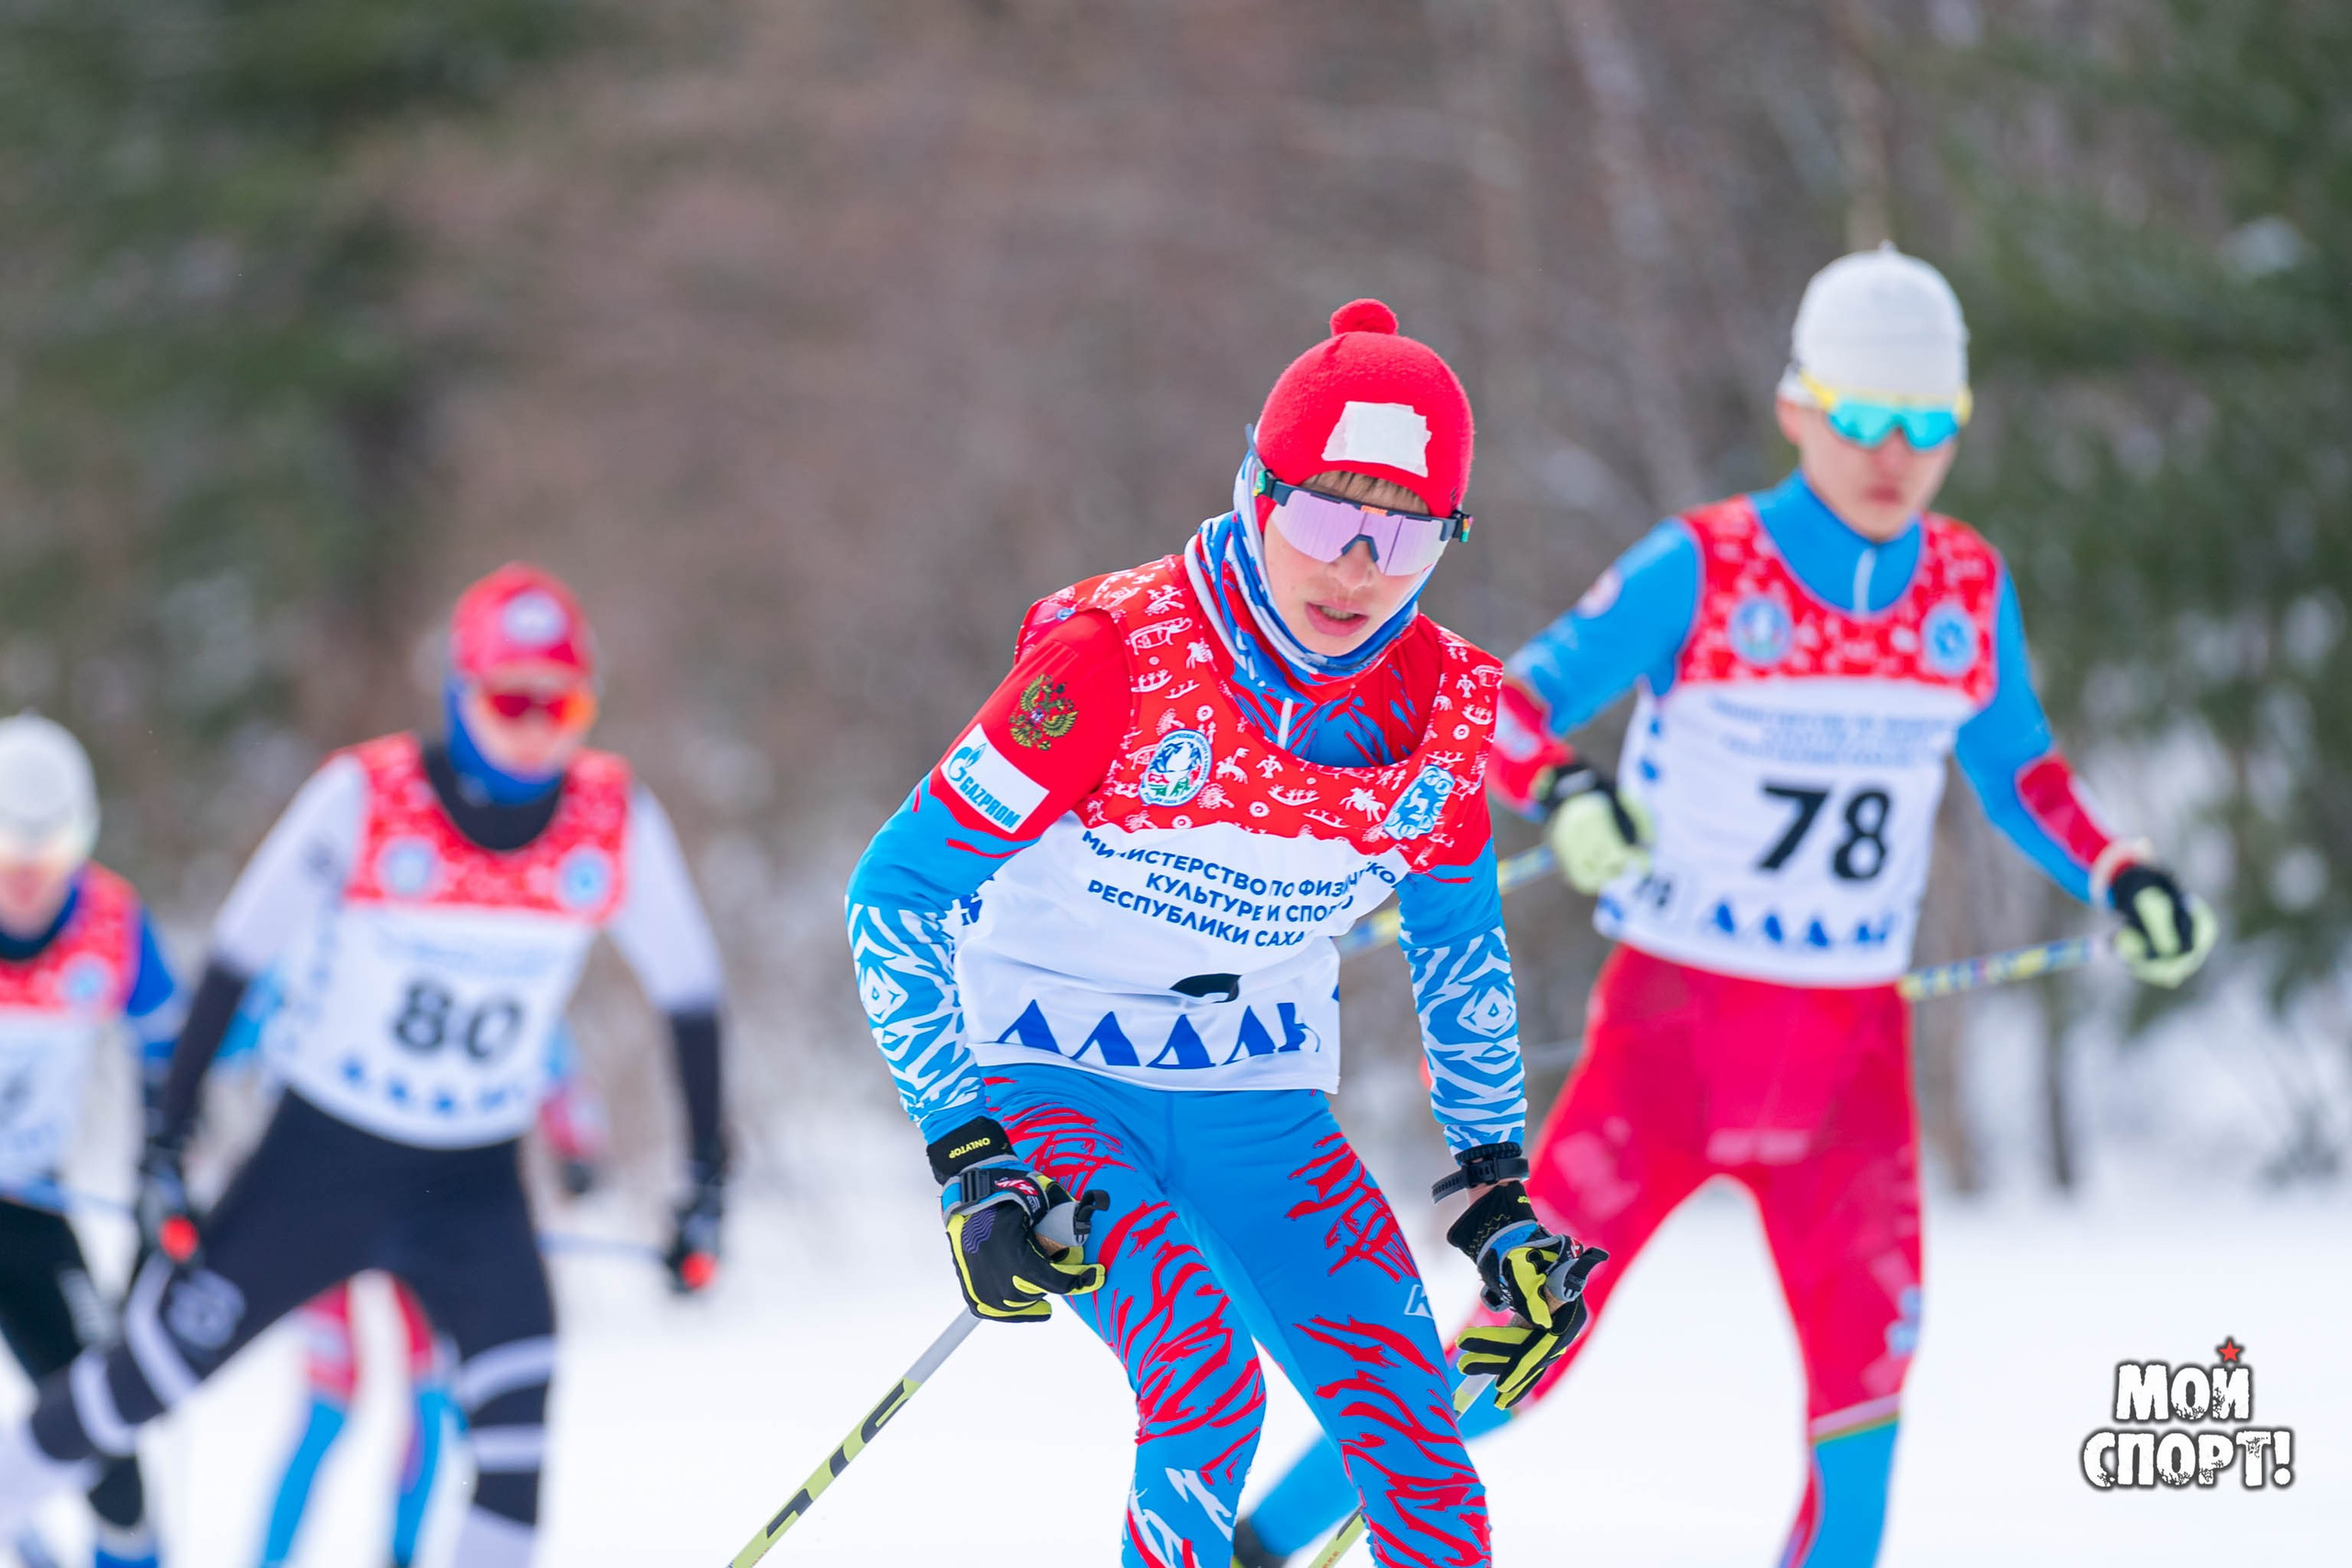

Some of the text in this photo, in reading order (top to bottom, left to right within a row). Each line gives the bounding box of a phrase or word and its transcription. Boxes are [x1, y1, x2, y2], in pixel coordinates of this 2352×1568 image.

[959, 776, 1022, 829] GAZPROM
[1758, 784, 1893, 884] 78
[1082, 830, 1267, 897] МИИСТЕРСТВО
[1270, 879, 1295, 898] ПО
[1146, 872, 1263, 922] КУЛЬТУРЕ
[1265, 905, 1281, 922] И
[1087, 879, 1250, 947] РЕСПУБЛИКИ
[393, 977, 524, 1066] 80
[948, 1137, 991, 1159] ONLYTOP
